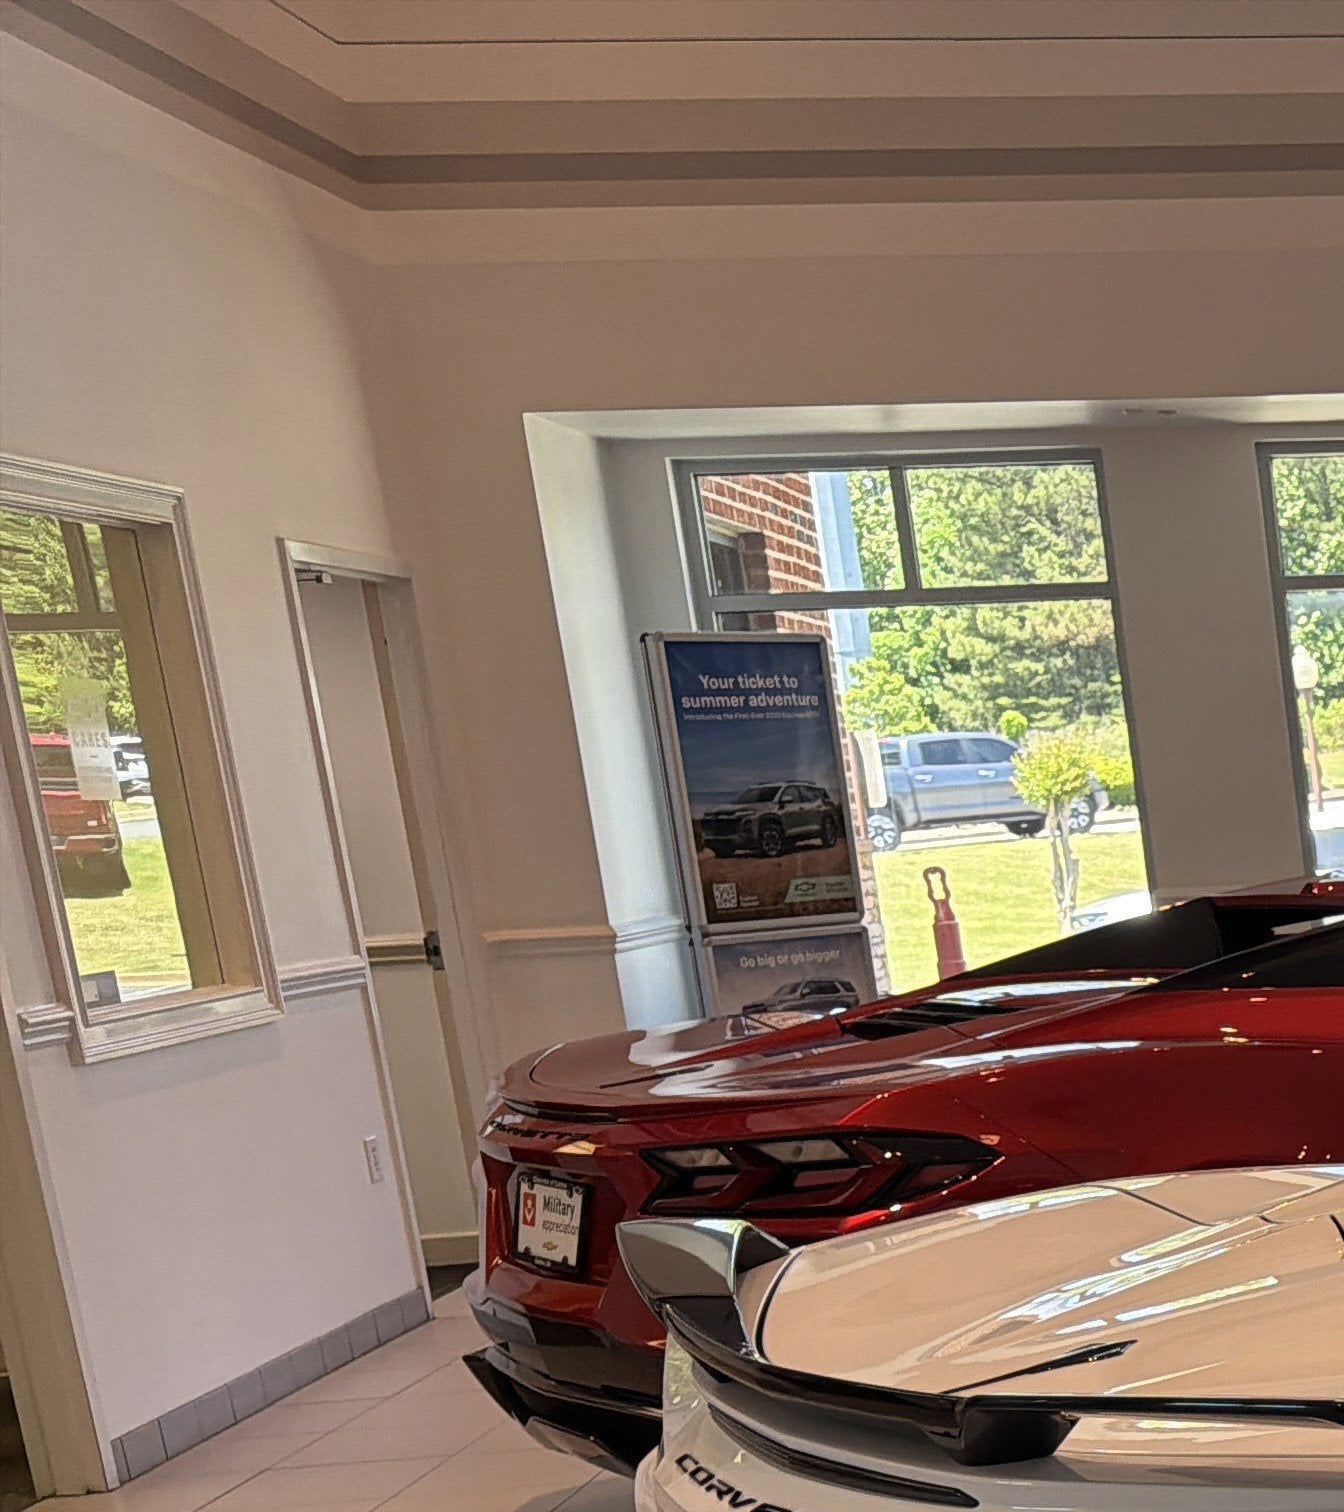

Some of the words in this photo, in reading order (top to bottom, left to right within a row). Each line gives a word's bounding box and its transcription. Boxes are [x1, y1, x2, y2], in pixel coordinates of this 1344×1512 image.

[699, 674, 734, 690] Your
[738, 673, 781, 689] ticket
[783, 675, 798, 688] to
[681, 695, 745, 709] summer
[748, 692, 819, 707] adventure
[740, 956, 755, 968] Go
[757, 954, 776, 968] big
[777, 954, 788, 965] or
[790, 953, 804, 965] go
[806, 949, 840, 963] bigger
[543, 1195, 575, 1221] Military
